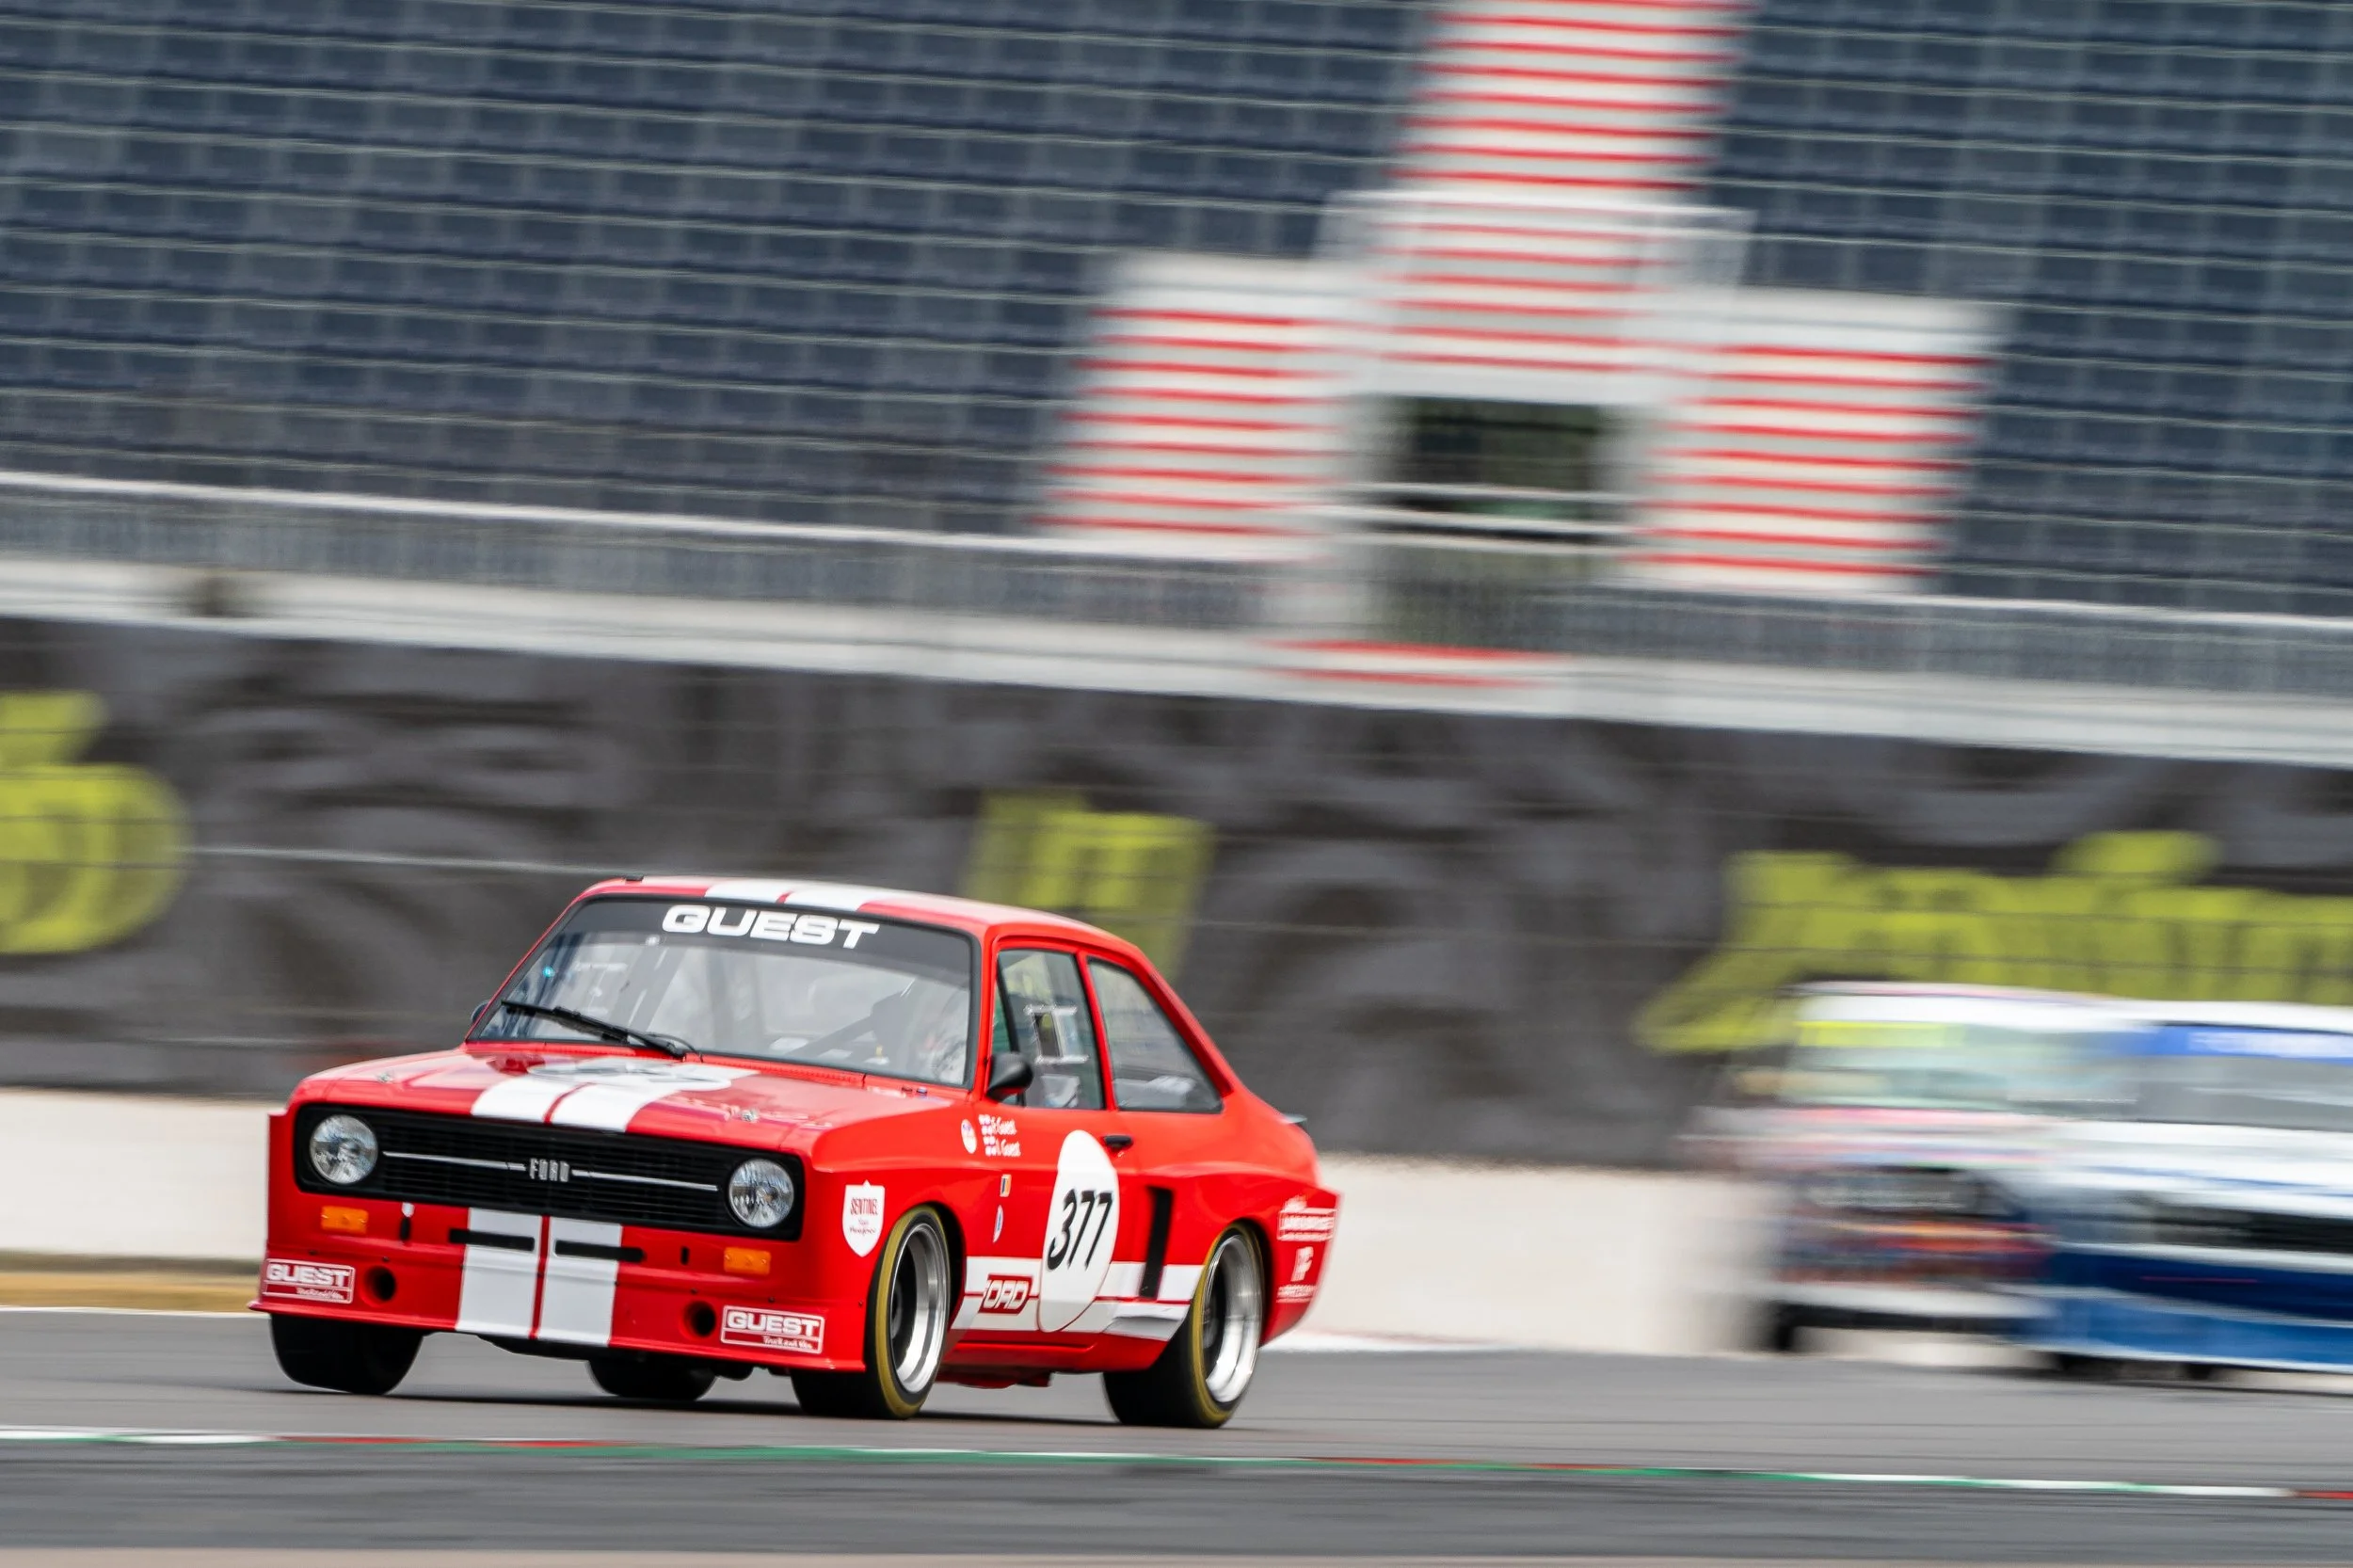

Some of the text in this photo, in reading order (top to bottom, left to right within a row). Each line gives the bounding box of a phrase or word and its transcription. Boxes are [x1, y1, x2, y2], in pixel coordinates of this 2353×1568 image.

[662, 904, 880, 950] GUEST
[529, 1158, 570, 1183] FORD
[1047, 1188, 1113, 1272] 377
[266, 1264, 350, 1287] GUEST
[728, 1311, 820, 1337] GUEST
